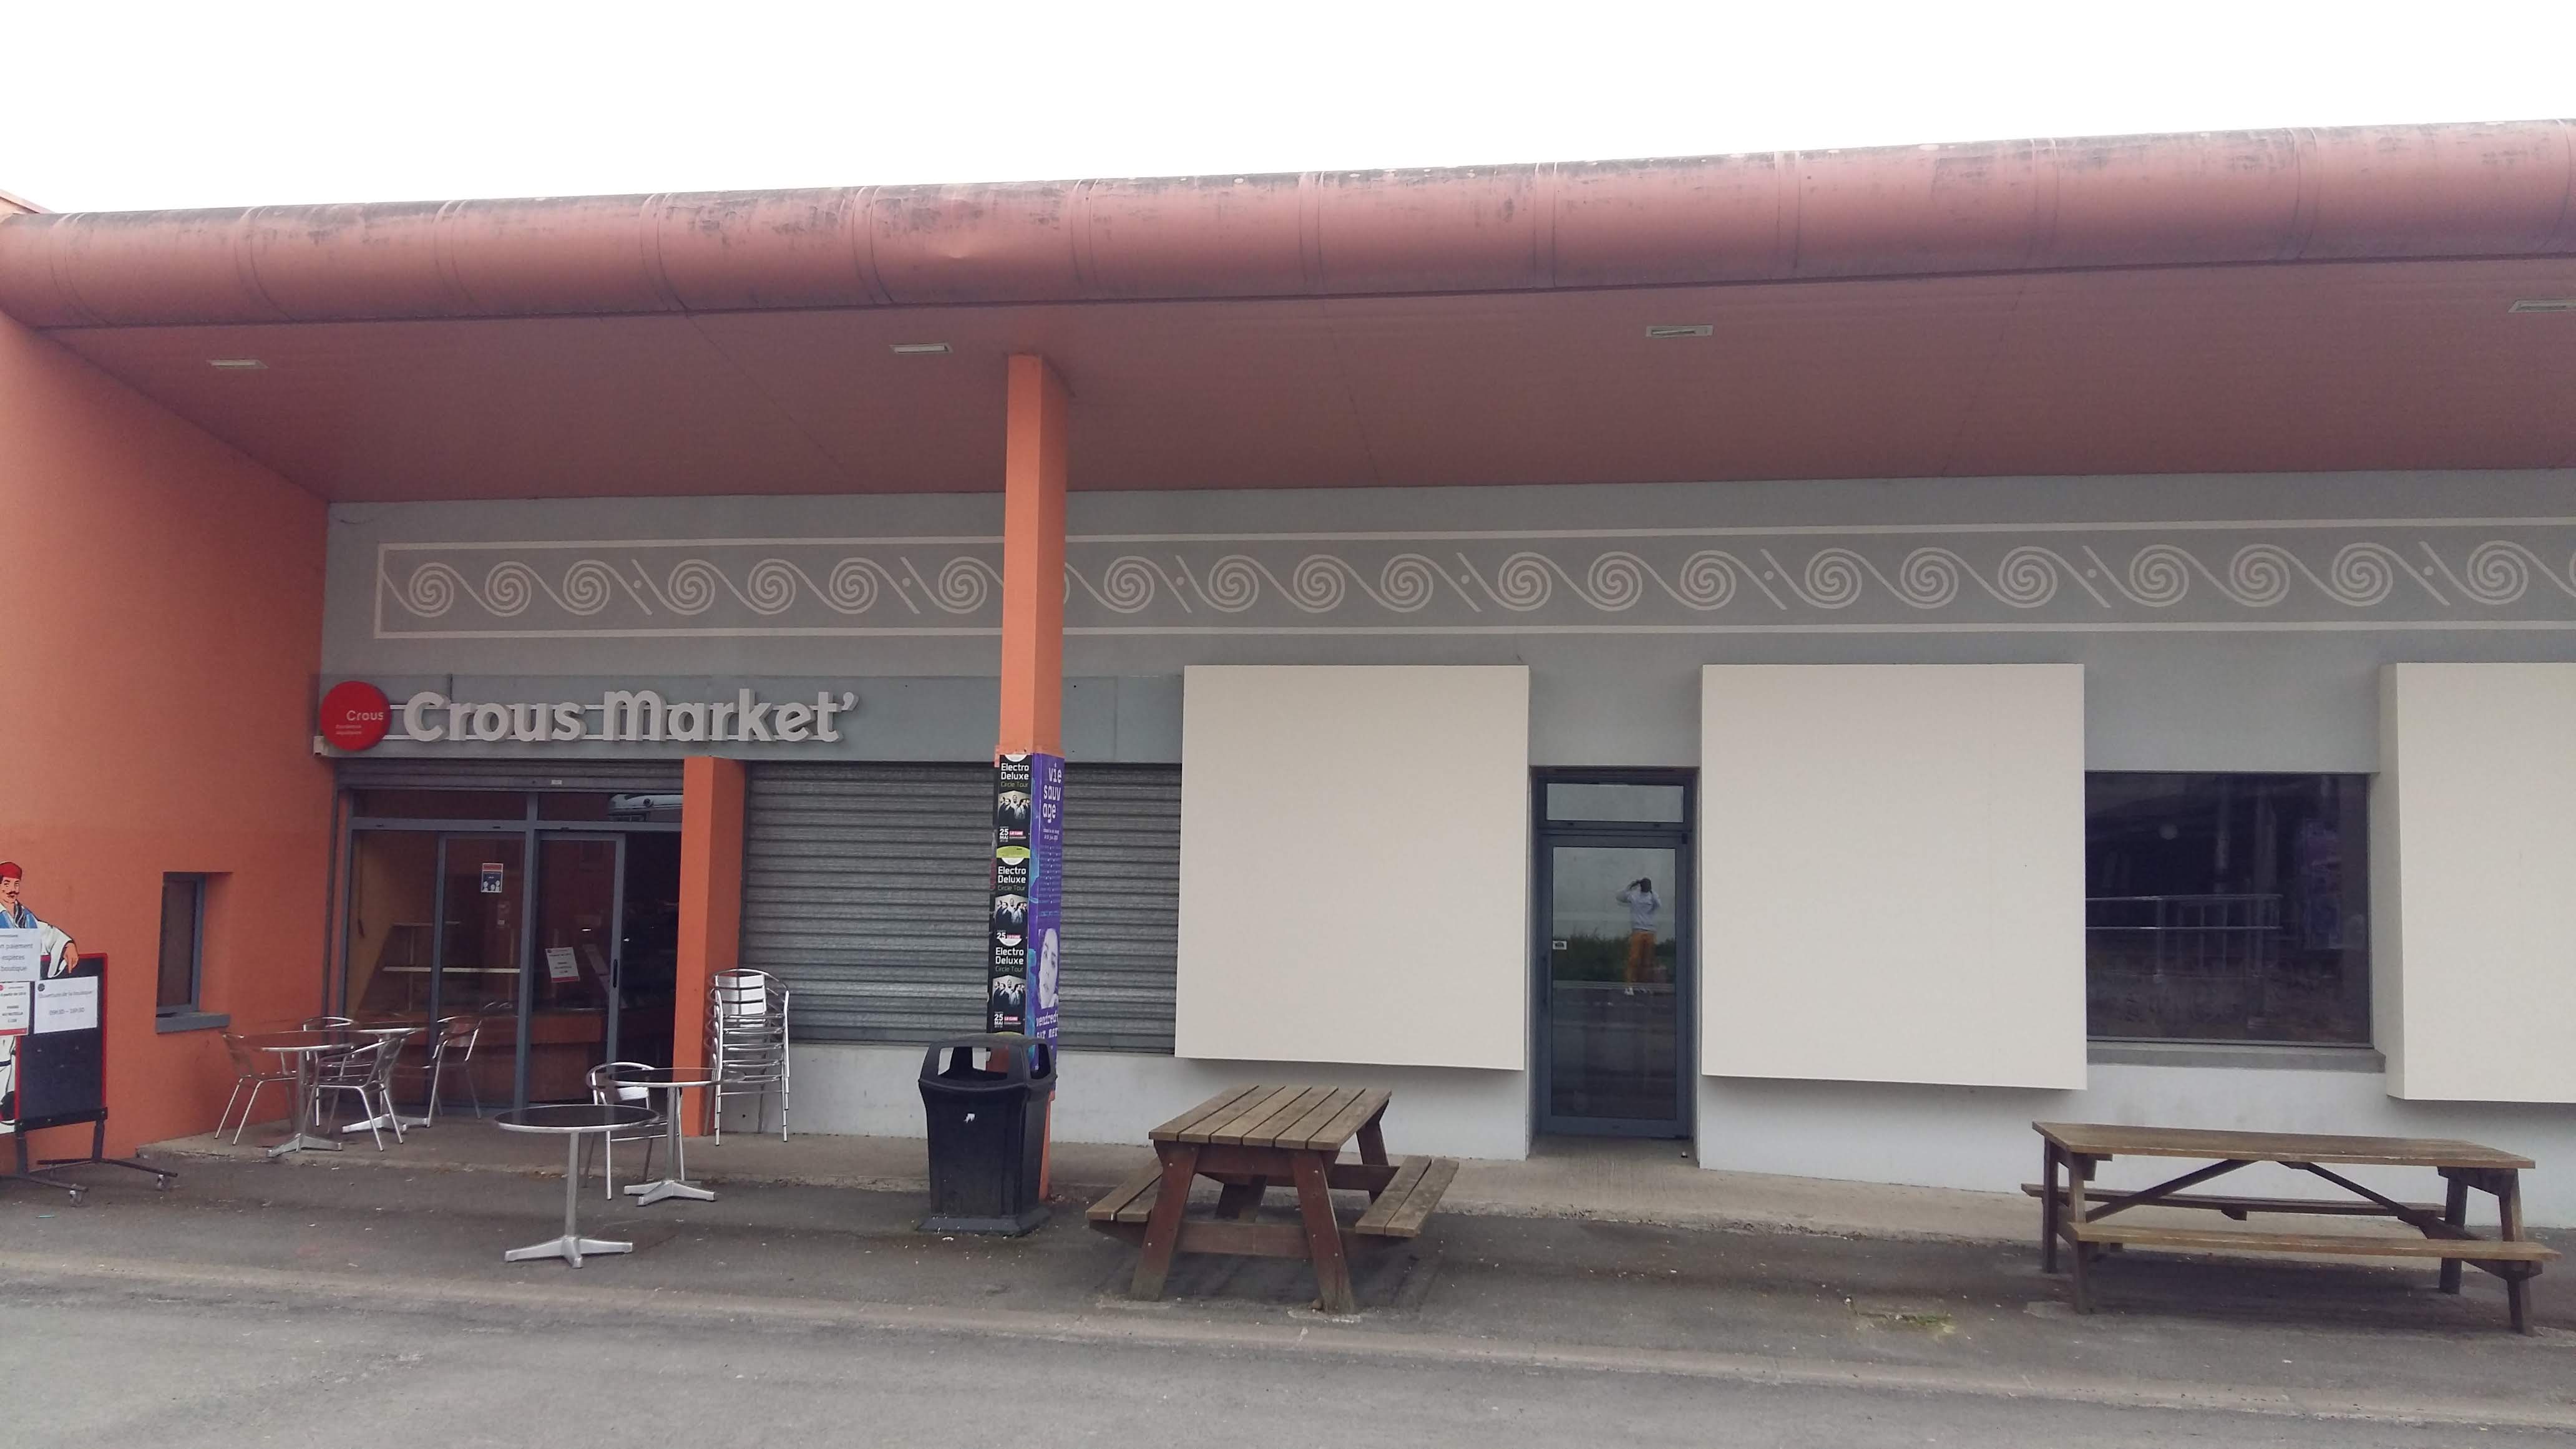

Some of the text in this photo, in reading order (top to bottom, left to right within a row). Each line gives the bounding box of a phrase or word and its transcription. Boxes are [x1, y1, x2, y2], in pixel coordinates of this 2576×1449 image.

[346, 710, 384, 721] Crous
[404, 691, 587, 741] Crous
[1000, 763, 1030, 771] Electro
[1000, 772, 1030, 780] Deluxe
[1048, 763, 1061, 783] vie
[1043, 785, 1061, 801] sauv
[1043, 803, 1056, 823] age
[998, 866, 1027, 874] Electro
[998, 875, 1027, 884] Deluxe
[995, 947, 1024, 955] Electro
[995, 956, 1024, 965] Deluxe
